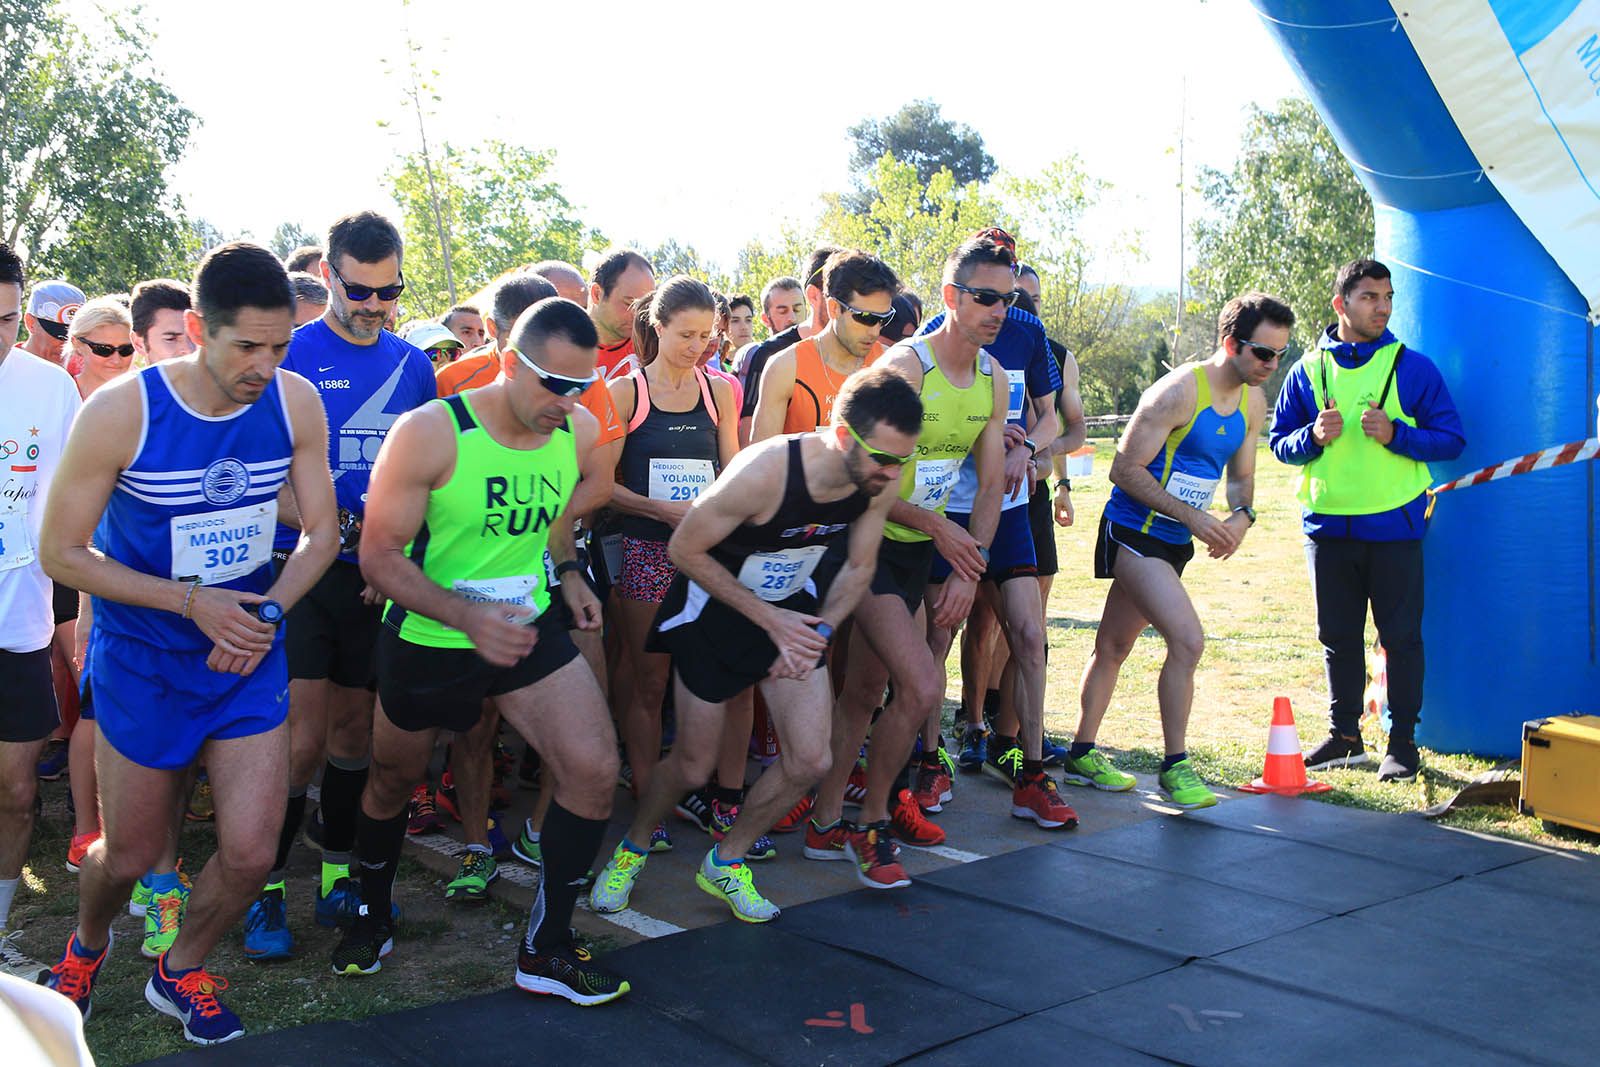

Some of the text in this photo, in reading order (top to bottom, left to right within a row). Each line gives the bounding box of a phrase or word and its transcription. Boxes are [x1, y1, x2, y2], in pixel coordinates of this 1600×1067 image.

[318, 379, 350, 389] 15862
[0, 478, 38, 502] apoli
[485, 469, 562, 509] RUN
[661, 474, 707, 483] YOLANDA
[670, 486, 700, 501] 291
[176, 518, 226, 532] MEDIJOCS
[480, 503, 560, 538] RUN
[190, 524, 262, 547] MANUEL
[204, 543, 249, 569] 302
